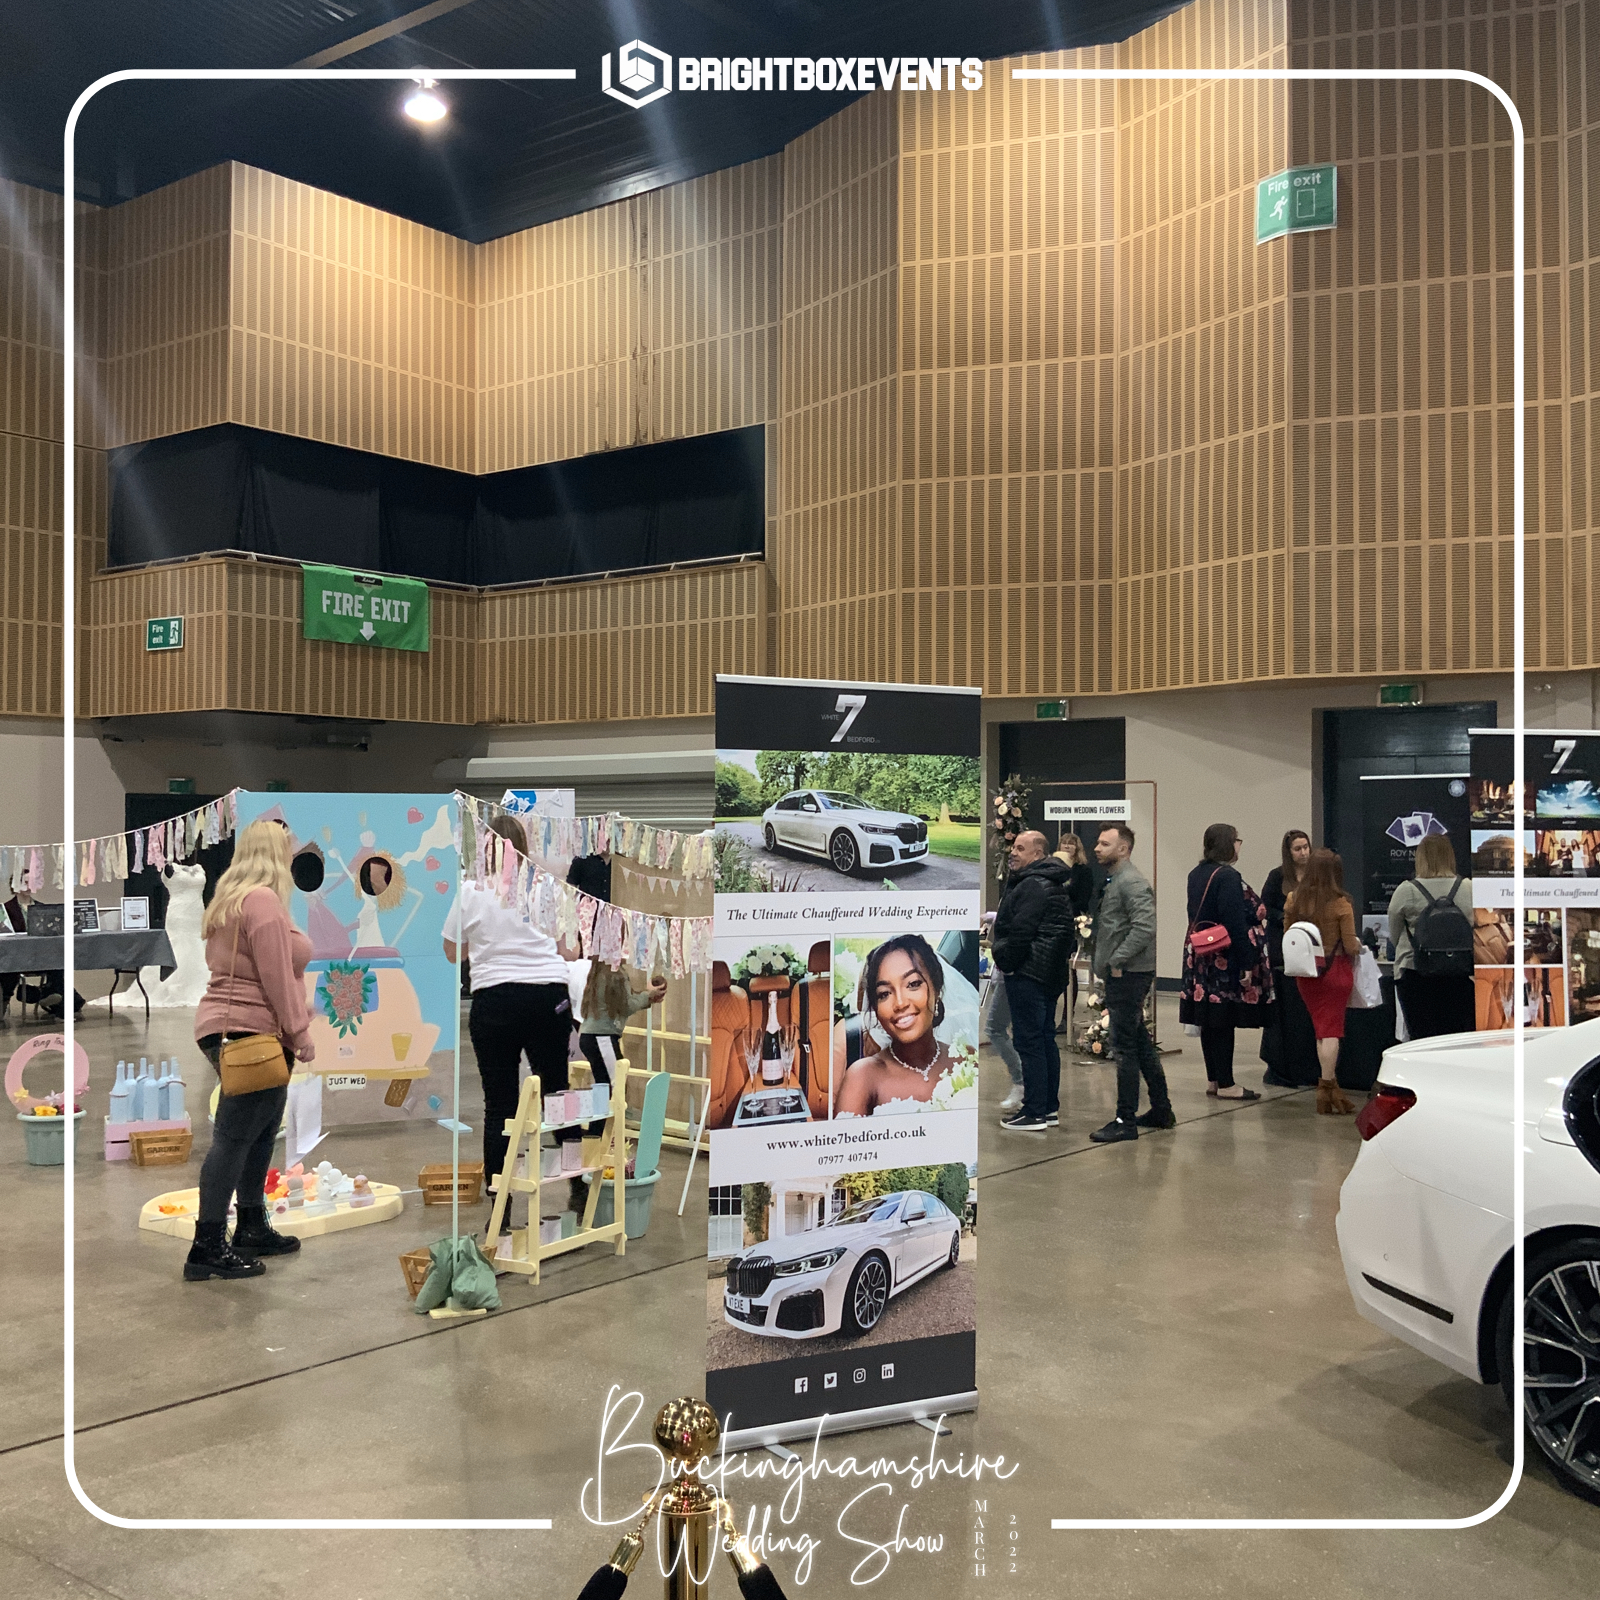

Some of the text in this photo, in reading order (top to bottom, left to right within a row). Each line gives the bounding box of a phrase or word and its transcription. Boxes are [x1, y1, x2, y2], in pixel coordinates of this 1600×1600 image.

[1268, 173, 1322, 196] Fire exit
[322, 590, 411, 624] FIRE EXIT
[152, 624, 164, 633] Fire
[152, 635, 164, 644] exit
[830, 694, 867, 743] 7
[846, 736, 875, 744] BEDFORD
[1550, 739, 1577, 774] 7
[1049, 806, 1125, 814] WOBURN WEDDING FLOWERS
[1524, 888, 1551, 897] ltimate
[727, 905, 968, 922] The Ultimate Chauffeured Wedding Experience
[328, 1077, 366, 1086] JUST WED
[766, 1126, 927, 1150] www.white7bedford.co.uk
[146, 1145, 181, 1154] GARDEN
[818, 1151, 878, 1166] 07977 407474
